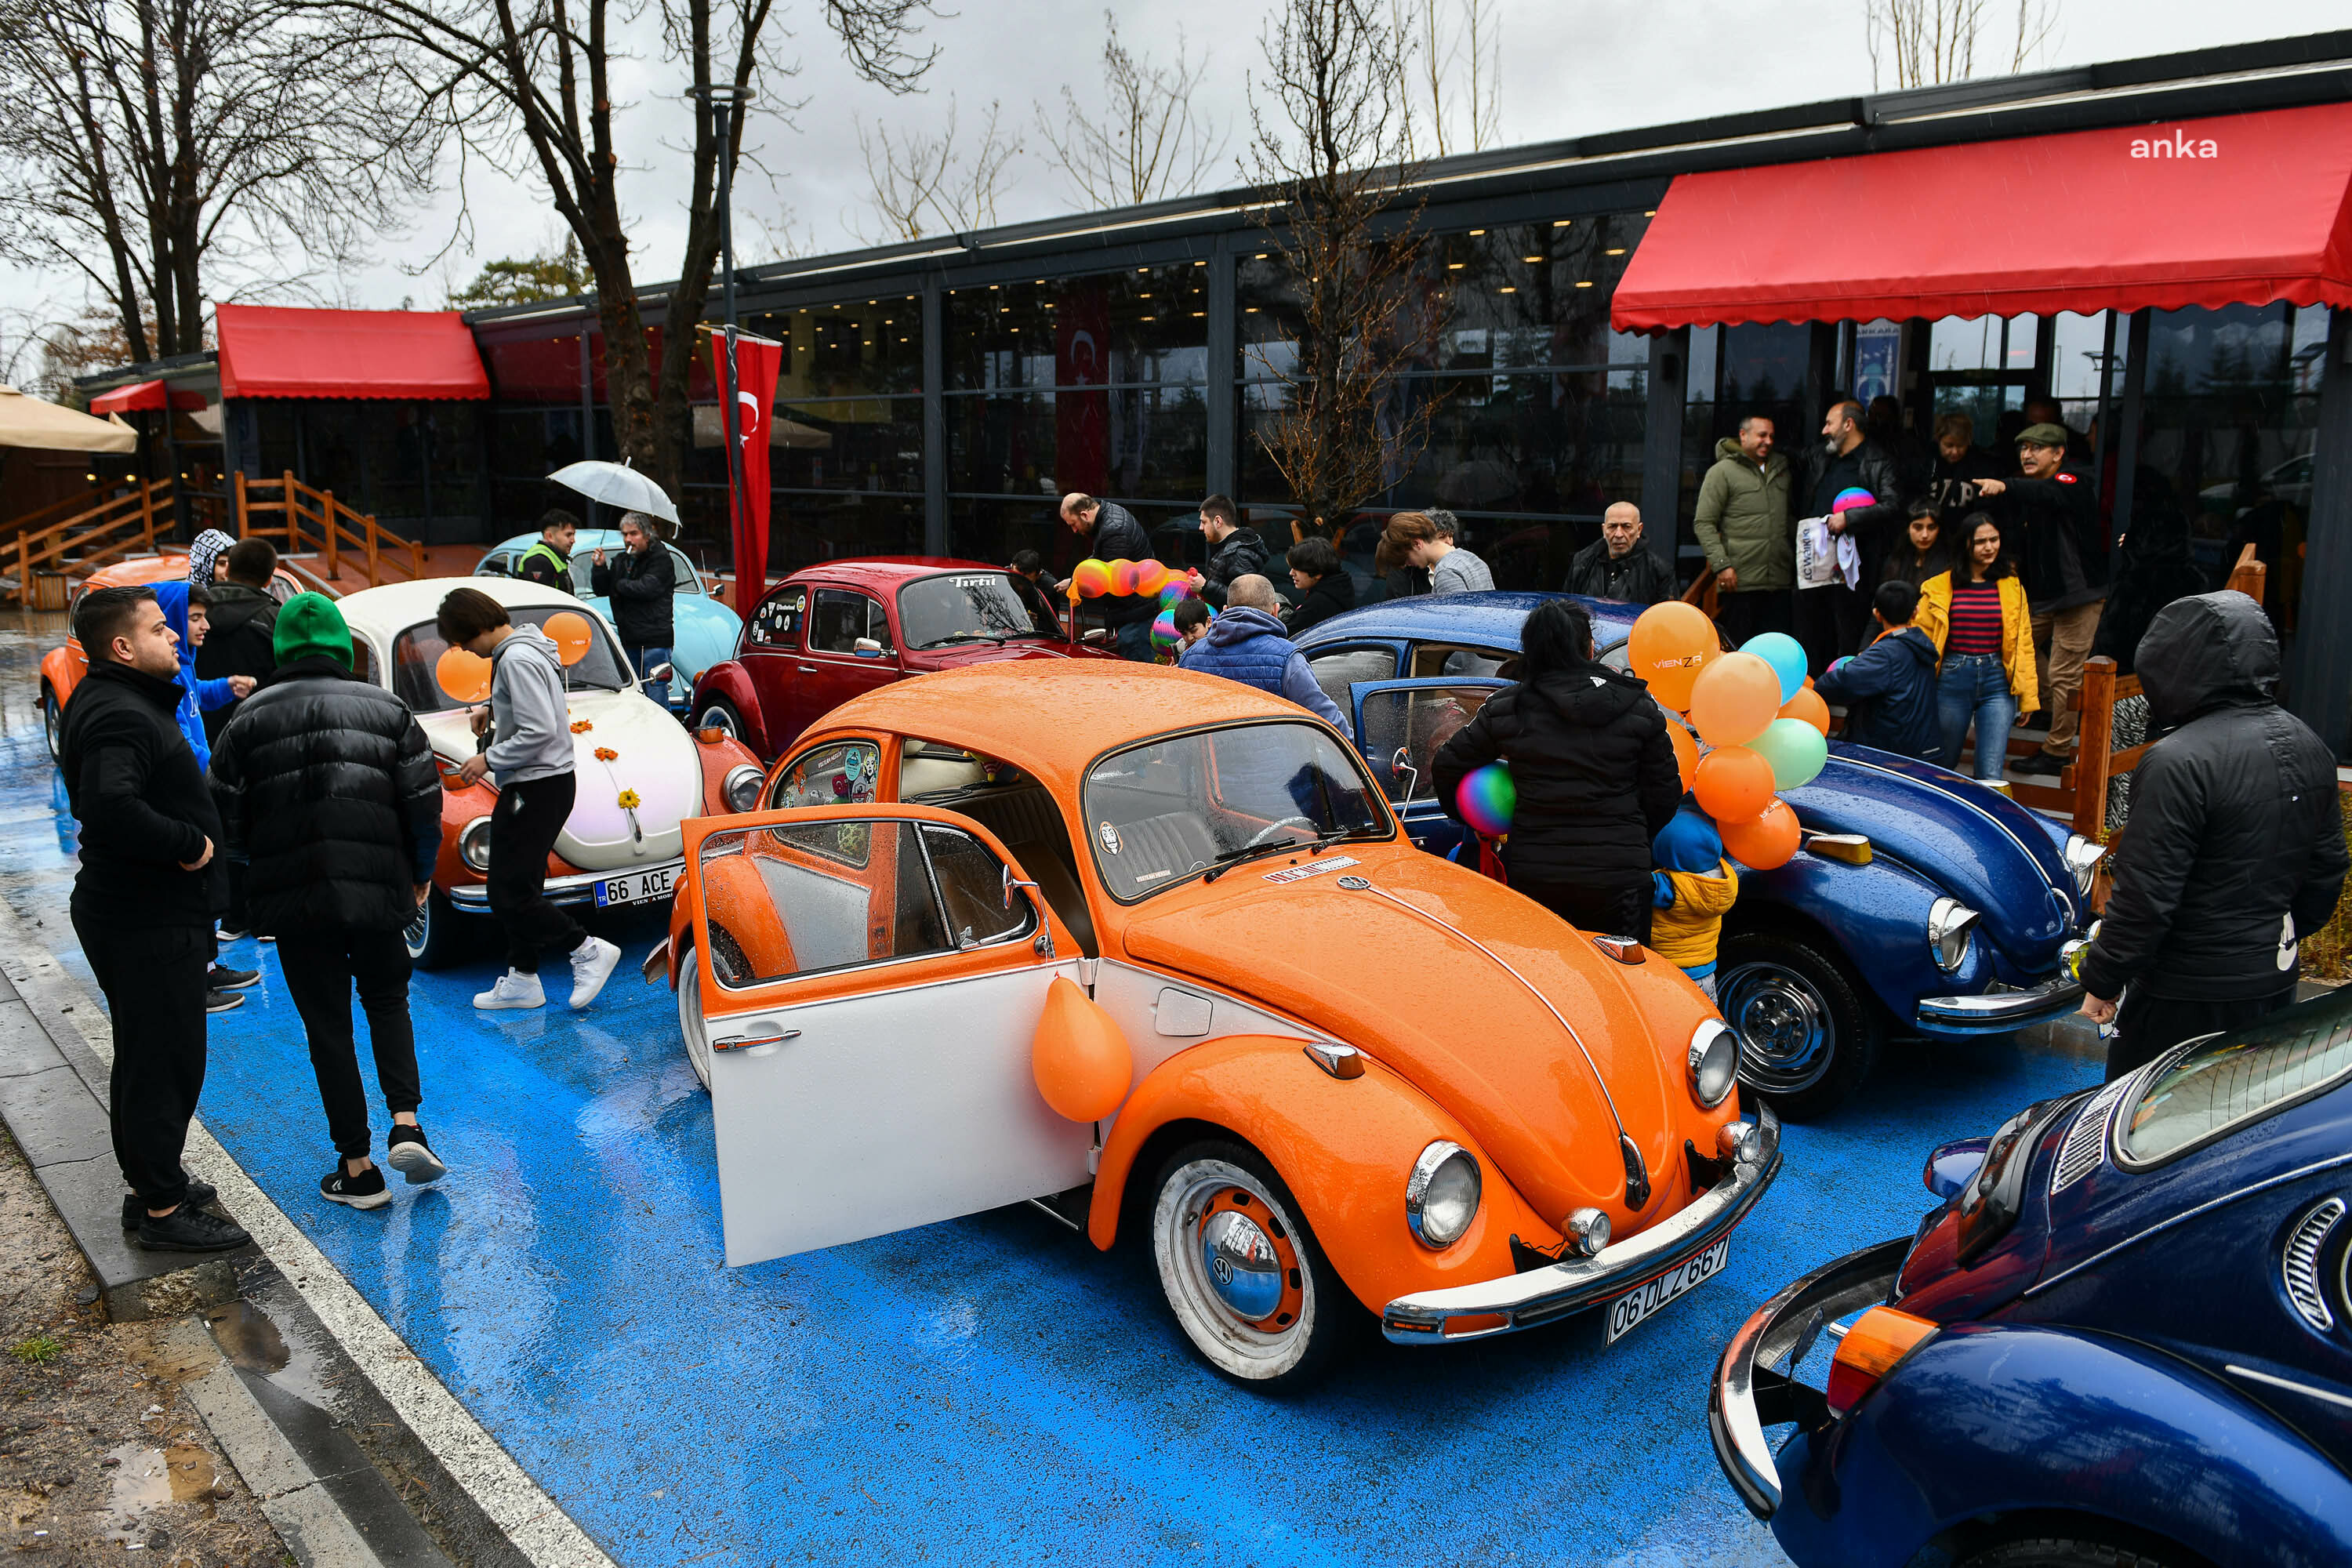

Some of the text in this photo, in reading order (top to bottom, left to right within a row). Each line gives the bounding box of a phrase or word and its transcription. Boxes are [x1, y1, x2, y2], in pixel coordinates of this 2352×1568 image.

[607, 870, 672, 902] 66 ACE
[1613, 1233, 1730, 1335] 06 DLZ 667
